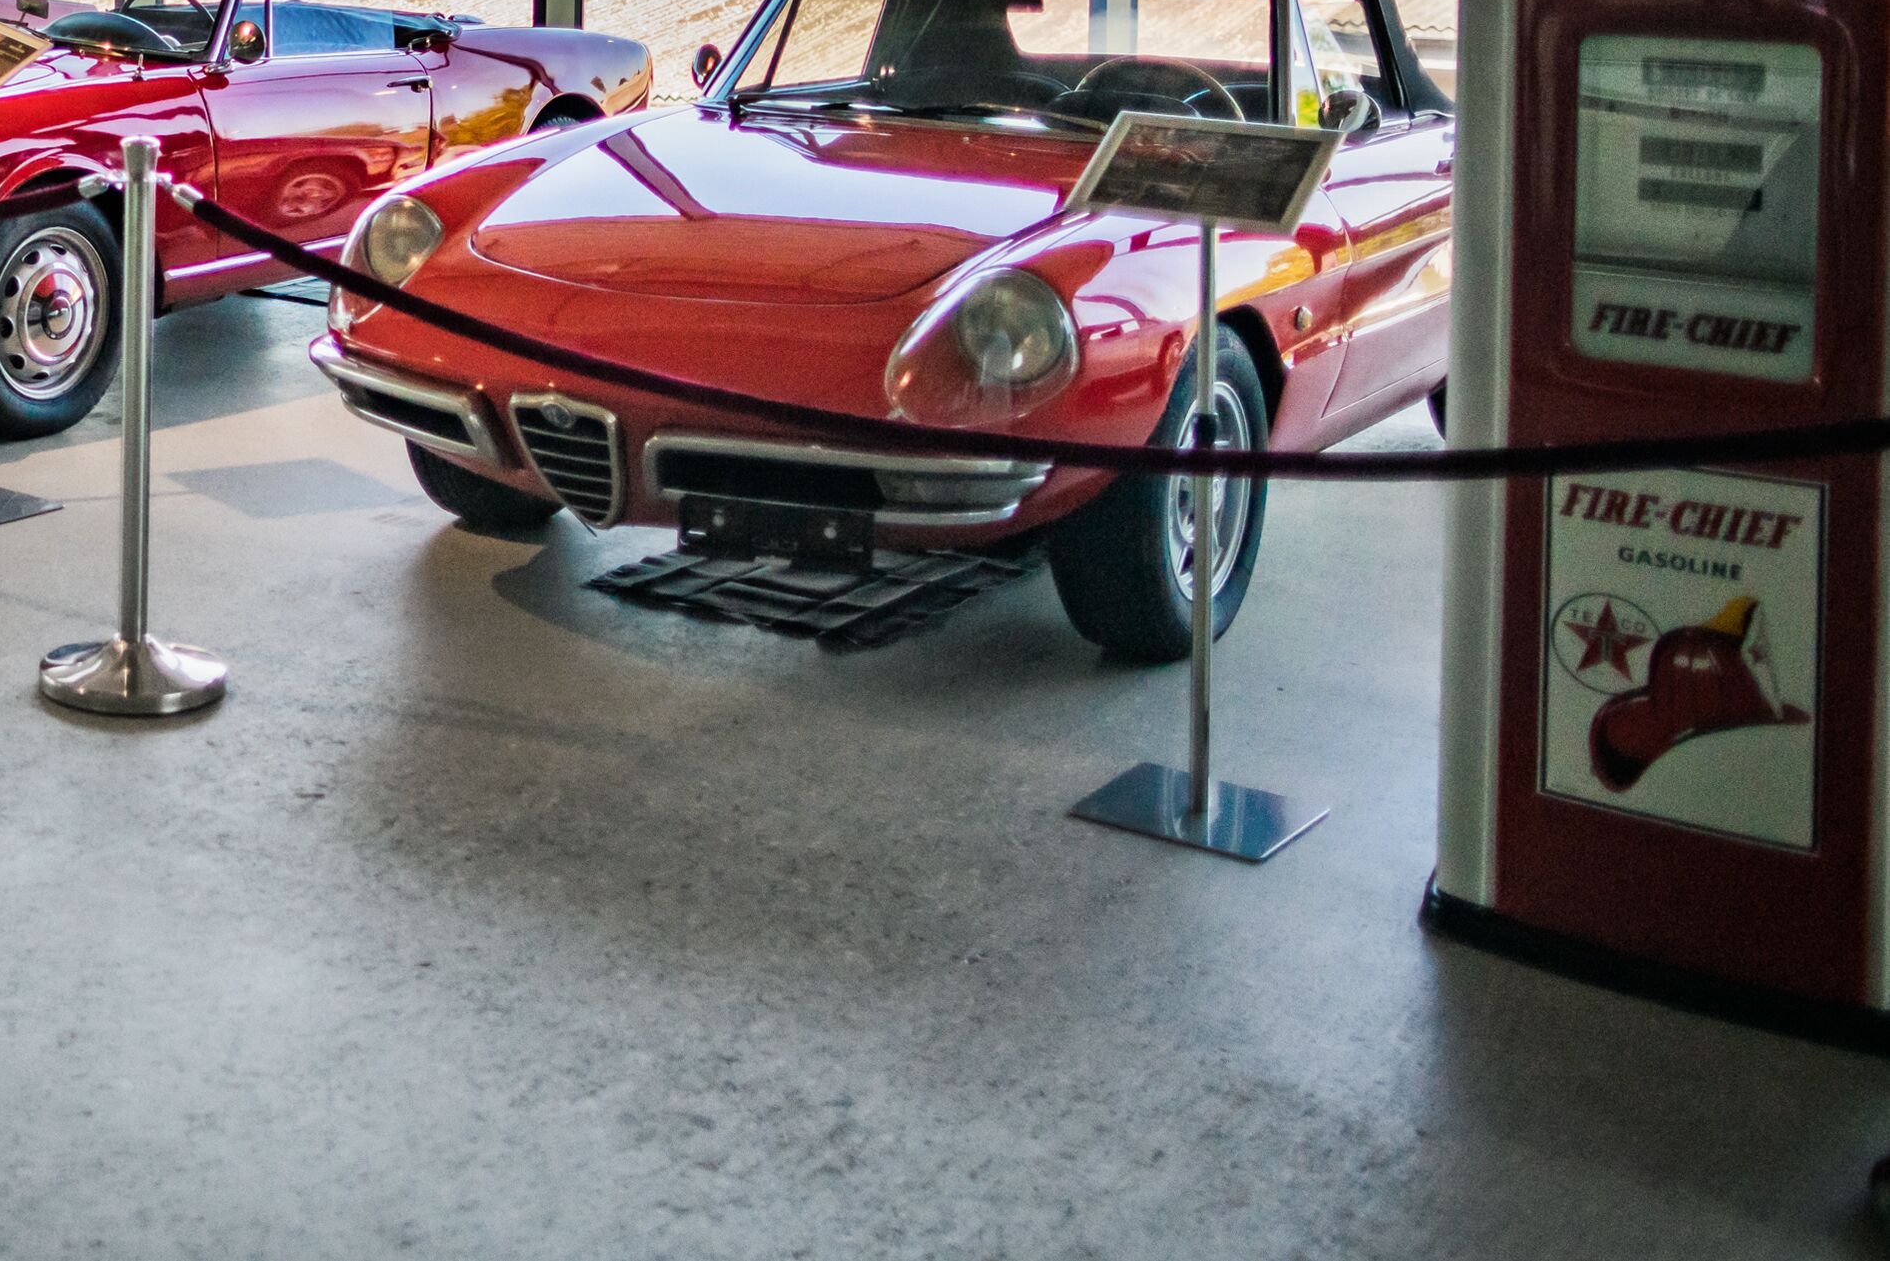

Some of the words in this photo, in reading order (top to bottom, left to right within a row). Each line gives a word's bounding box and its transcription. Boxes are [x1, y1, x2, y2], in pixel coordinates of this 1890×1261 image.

[1589, 303, 1800, 353] FIRE-CHIEF
[1561, 484, 1801, 548] FIRE-CHIEF
[1618, 547, 1743, 581] GASOLINE
